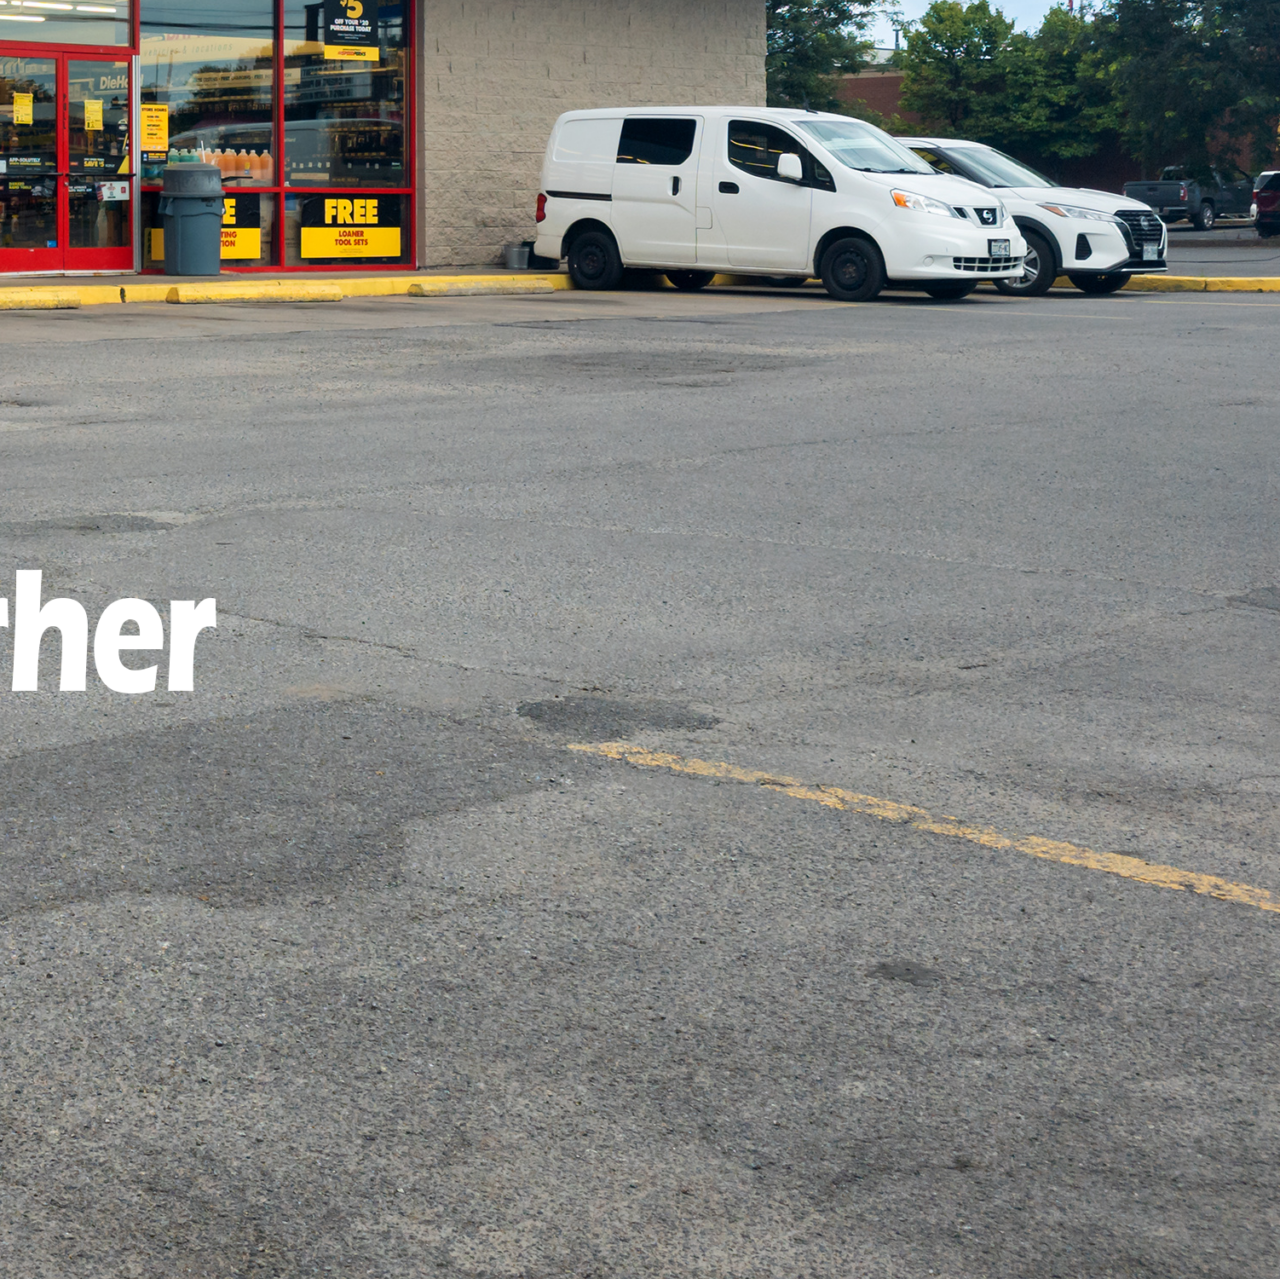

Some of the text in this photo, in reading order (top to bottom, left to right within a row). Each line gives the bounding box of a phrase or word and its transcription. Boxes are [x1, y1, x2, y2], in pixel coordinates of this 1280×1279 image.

[330, 24, 354, 32] PURCHASE
[191, 42, 234, 54] locations
[100, 74, 143, 90] DieH
[324, 199, 378, 224] FREE
[353, 238, 368, 246] SETS
